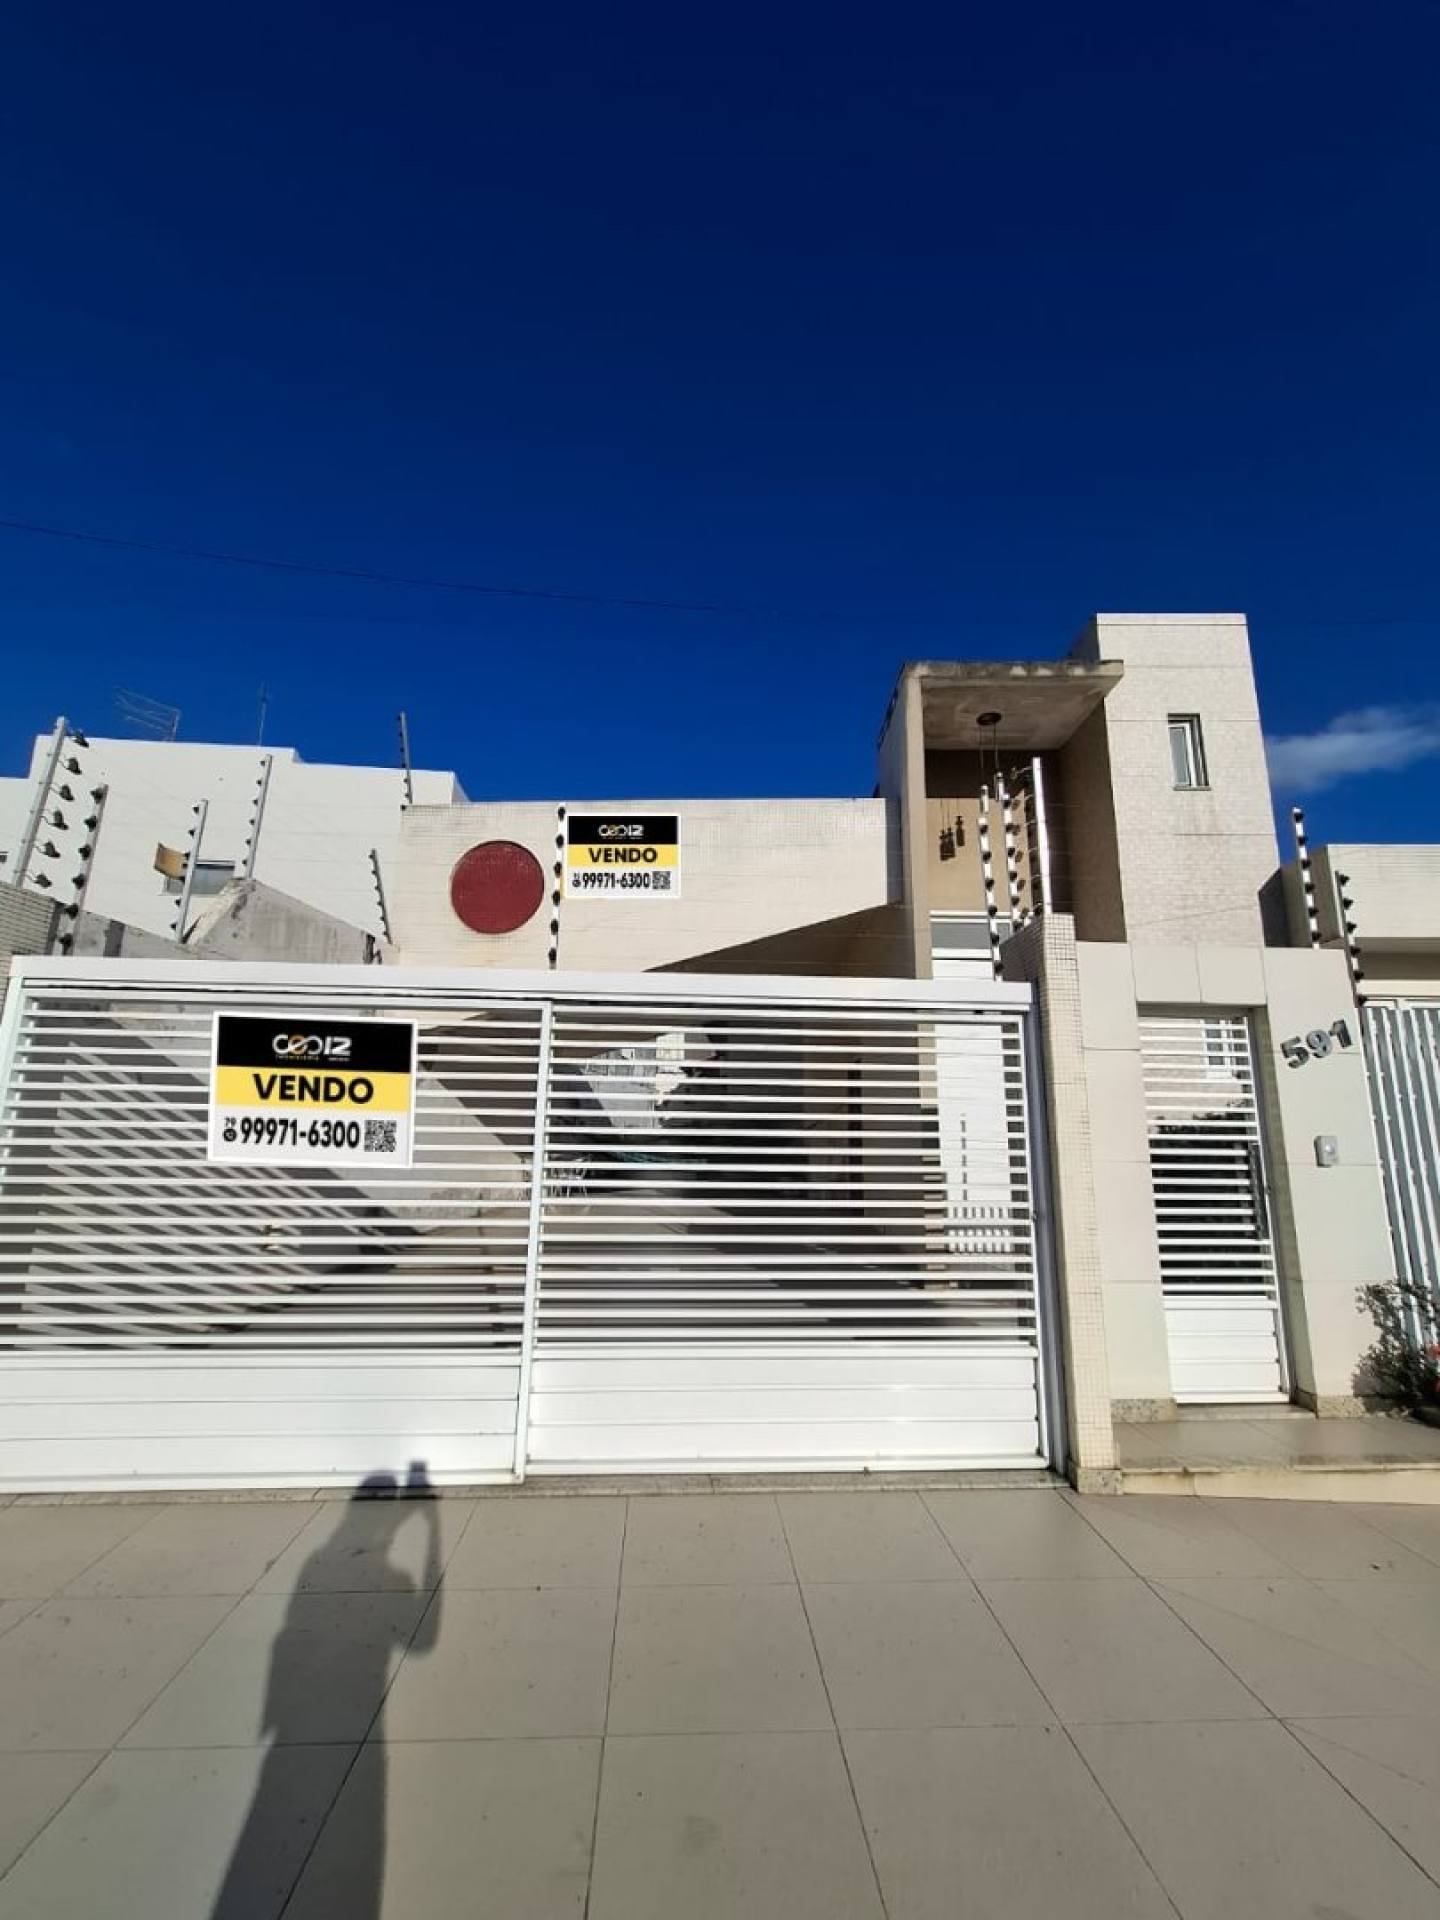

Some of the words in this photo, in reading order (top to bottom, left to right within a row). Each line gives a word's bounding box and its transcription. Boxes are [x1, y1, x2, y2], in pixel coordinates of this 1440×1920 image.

[588, 847, 658, 863] VENDO
[582, 872, 650, 889] 99971-6300
[1280, 1019, 1352, 1069] 591
[253, 1073, 374, 1104] VENDO
[240, 1116, 360, 1149] 99971-6300
